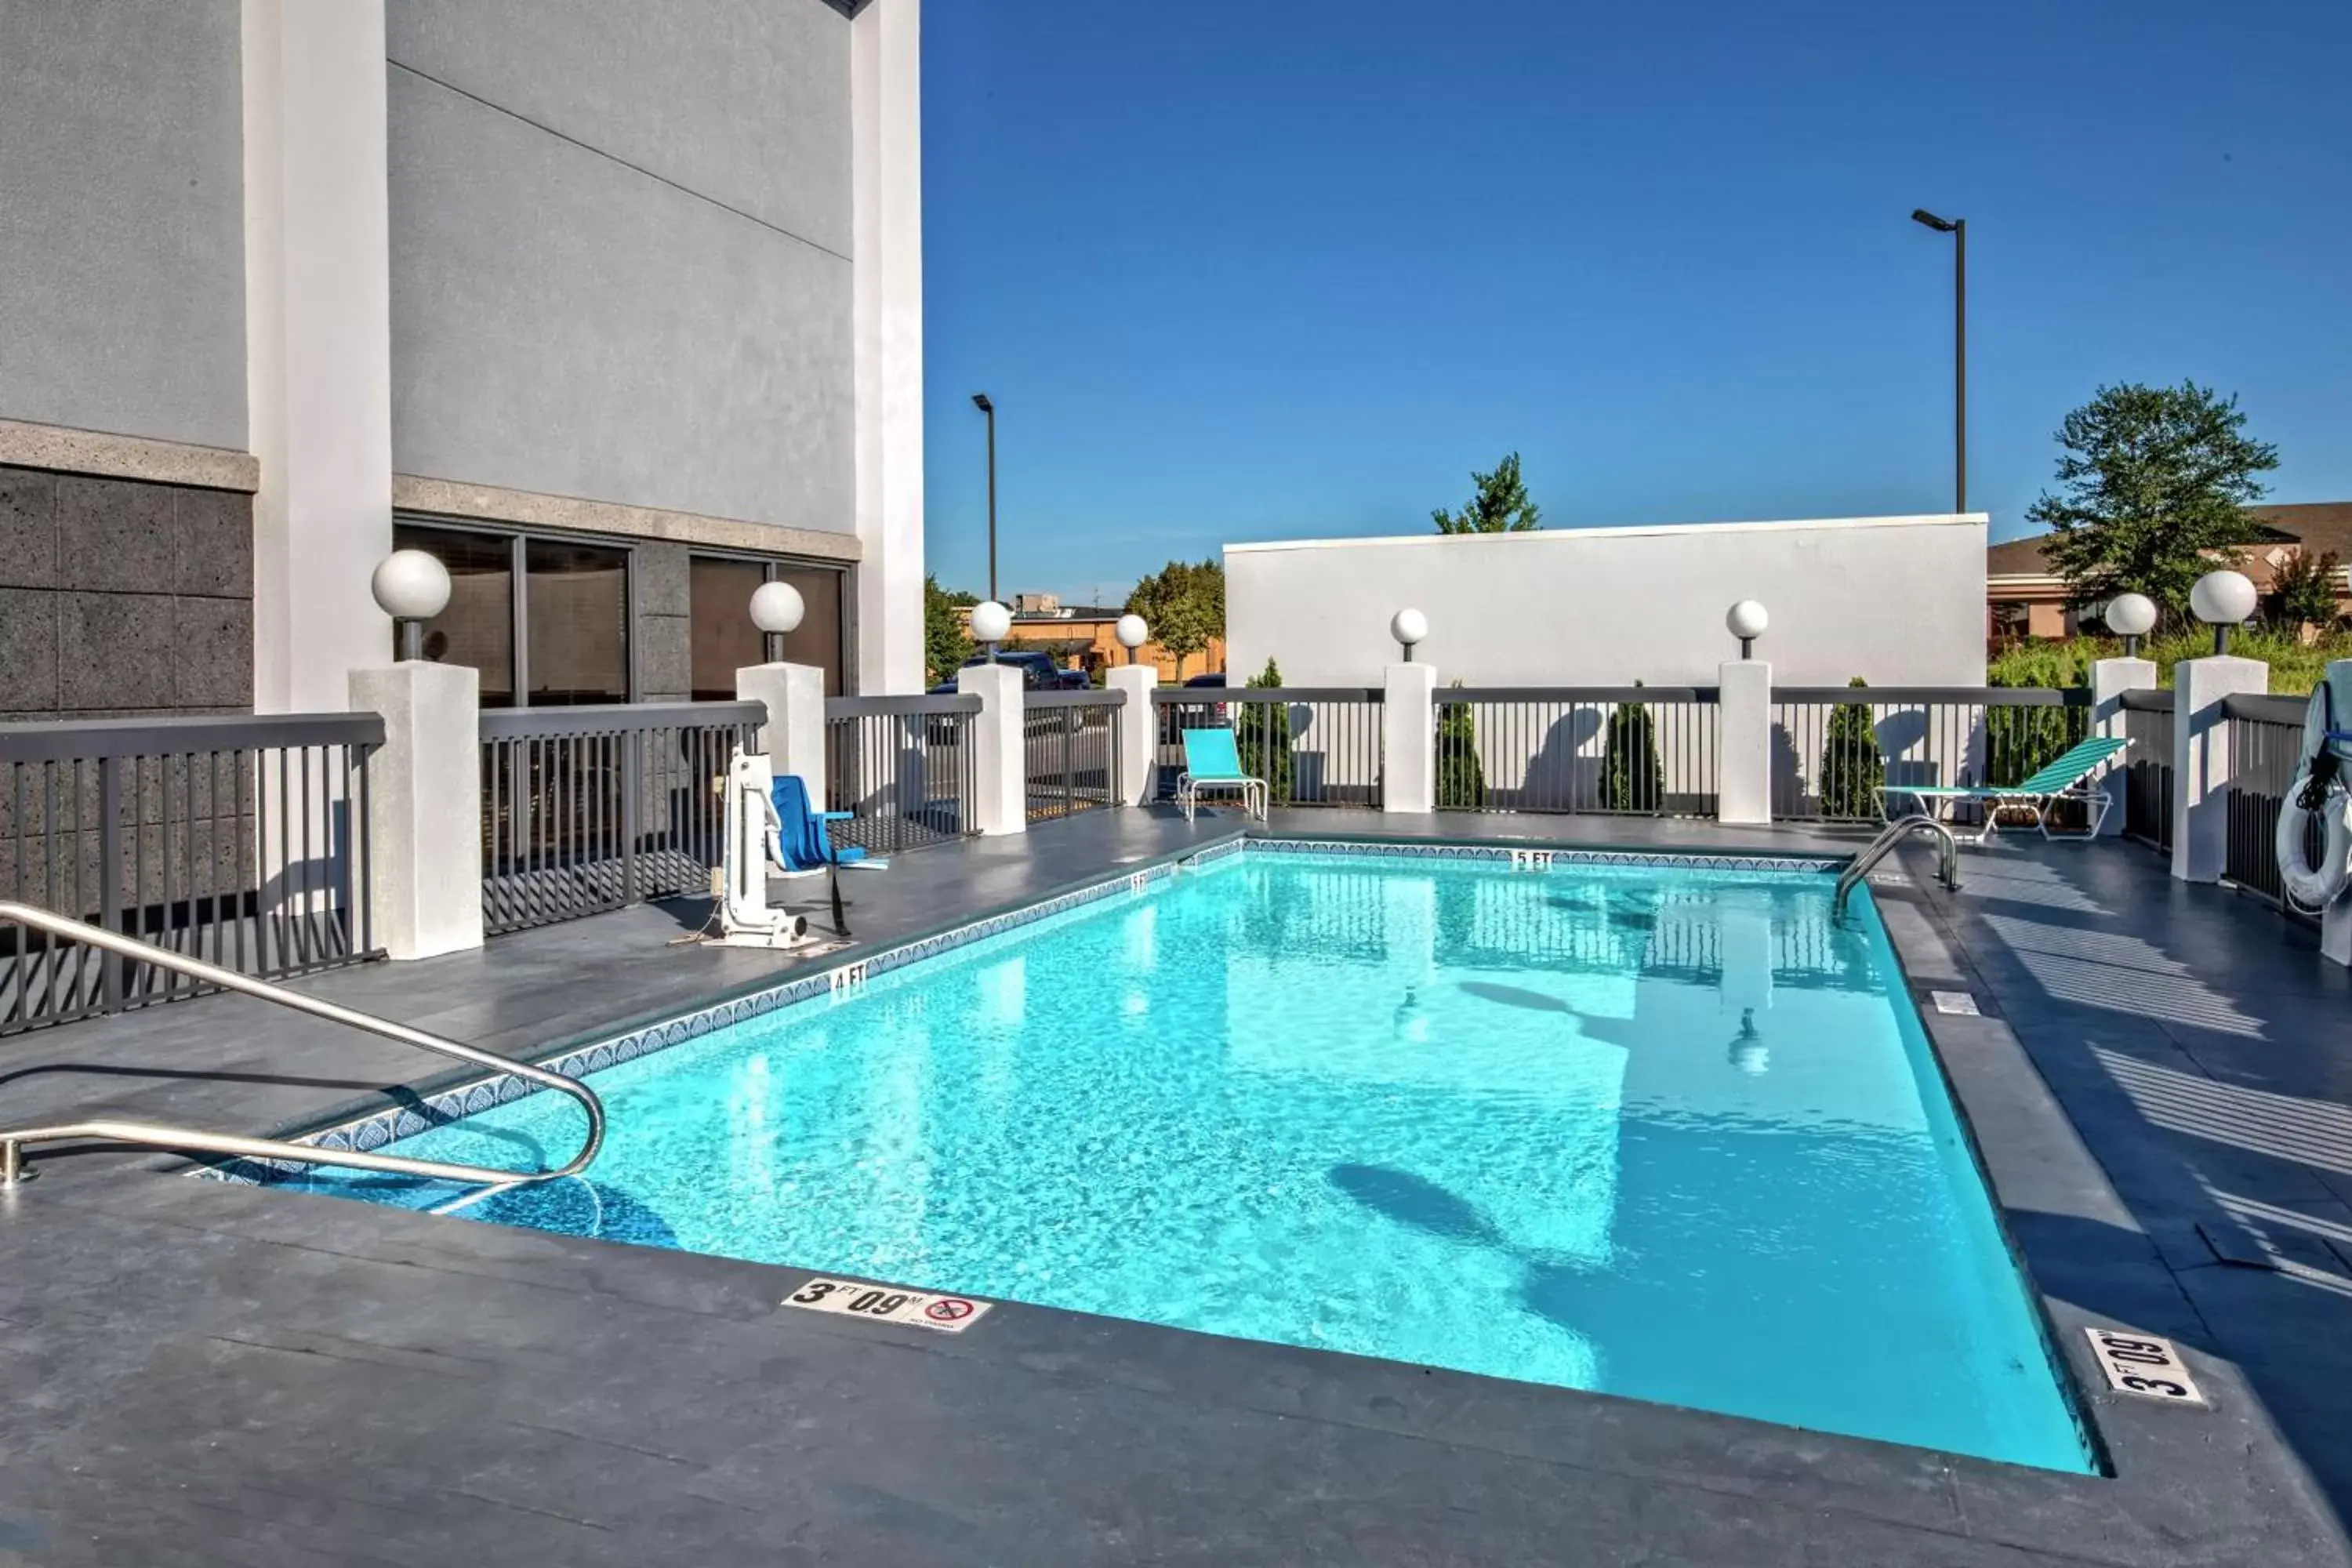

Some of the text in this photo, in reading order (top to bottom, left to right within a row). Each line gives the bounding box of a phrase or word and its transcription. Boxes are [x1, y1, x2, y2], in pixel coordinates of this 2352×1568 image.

[1533, 852, 1550, 863] FT
[849, 964, 864, 985] FT
[793, 1283, 837, 1303] 3
[837, 1285, 862, 1296] FT
[2122, 1376, 2187, 1396] 3
